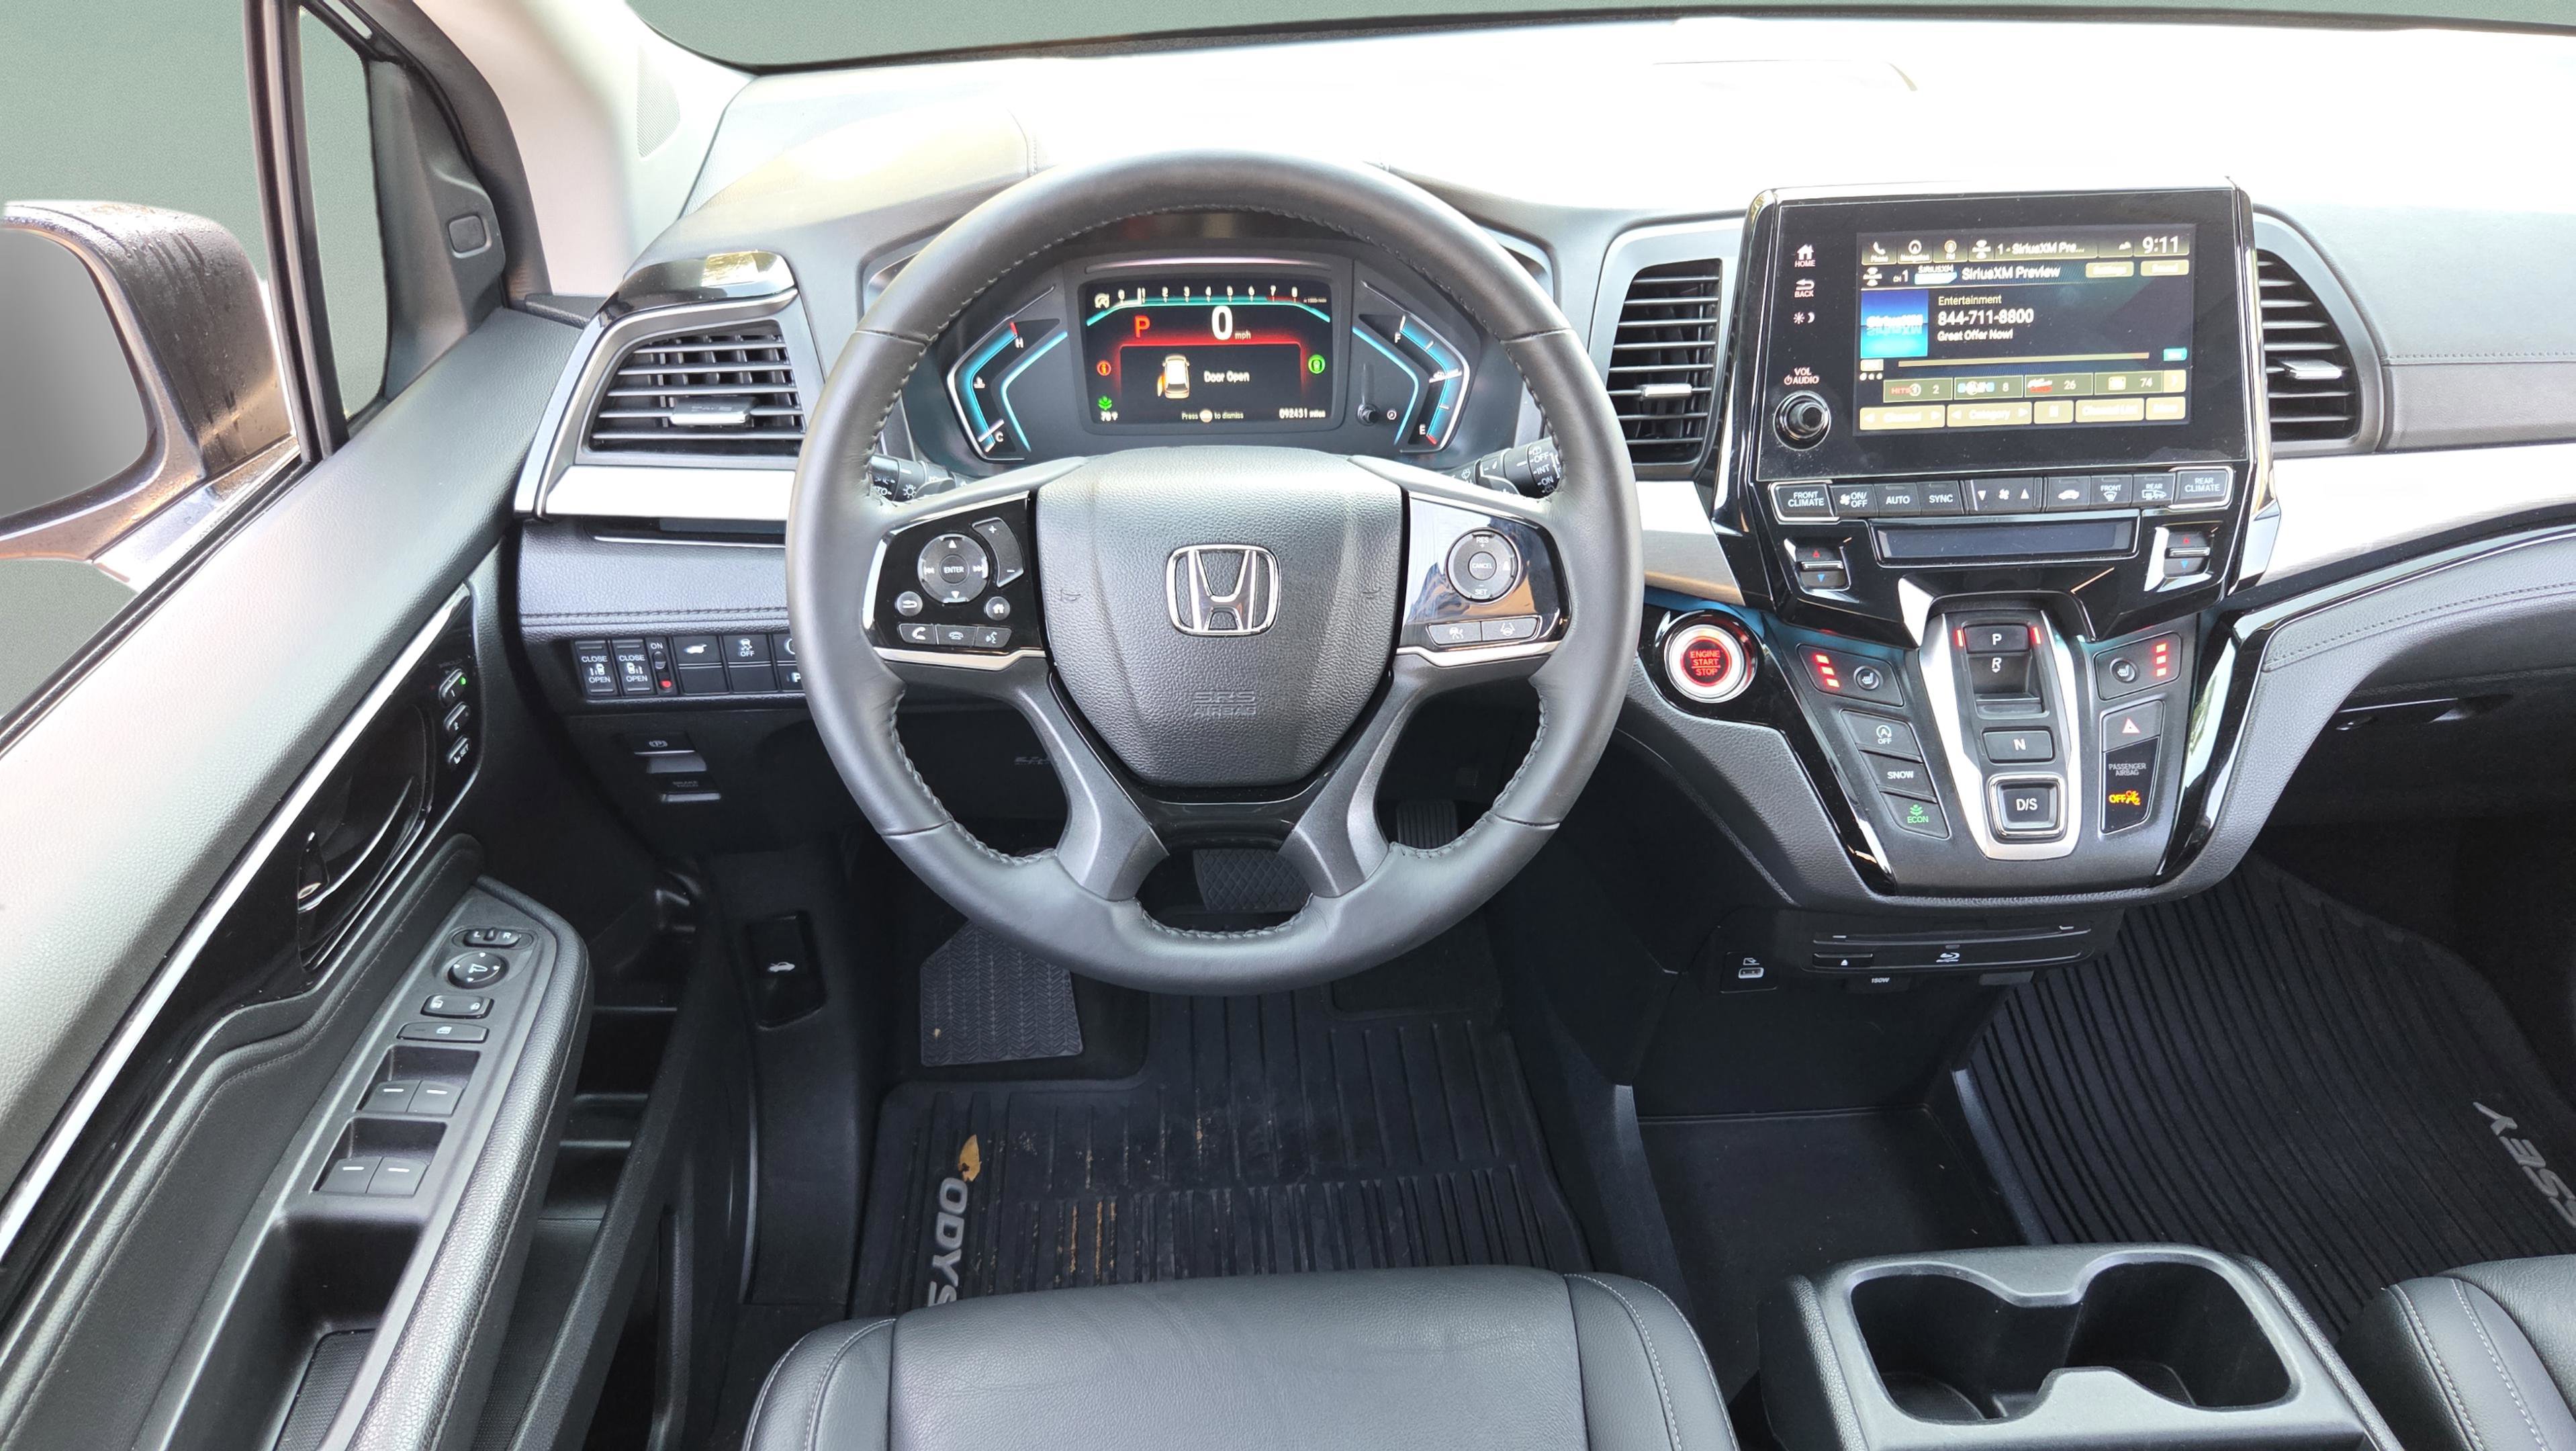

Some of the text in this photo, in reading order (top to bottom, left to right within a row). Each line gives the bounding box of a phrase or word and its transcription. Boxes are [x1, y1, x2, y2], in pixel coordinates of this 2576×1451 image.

[1997, 244, 2003, 255] 1
[2012, 241, 2057, 255] SiriusXM
[2142, 236, 2178, 254] 9:11
[1794, 259, 1816, 268] HOME
[1902, 269, 1908, 282] 1
[1962, 267, 2013, 281] SiriusXM
[2016, 265, 2061, 279] Preview
[1162, 286, 1168, 297] 2
[1794, 290, 1814, 298] BACK
[1938, 294, 2002, 306] Entertainment
[1938, 308, 2034, 326] 844-711-8800
[1134, 314, 1150, 338] P
[1211, 306, 1251, 341] 0 mph
[1395, 333, 1401, 344] F
[1938, 330, 1962, 342] Great
[1964, 329, 1987, 341] Offer
[1015, 337, 1024, 349] H
[1204, 370, 1250, 383] Door Open
[1794, 367, 1812, 376] VOL
[1792, 376, 1819, 385] AUDIO
[2064, 380, 2076, 390] 26
[2140, 378, 2154, 388] 74
[1933, 386, 1939, 394] 2
[2003, 383, 2009, 392] 8
[1222, 411, 1244, 419] dismiss
[1279, 408, 1308, 419] 092431
[1420, 424, 1426, 435] E
[995, 431, 1004, 443] C
[1534, 452, 1549, 463] OFF
[1536, 464, 1550, 475] INT
[1541, 476, 1553, 486] ON
[2195, 477, 2214, 485] REAR
[2100, 484, 2121, 492] FRONT
[2146, 483, 2163, 491] REAR
[2184, 483, 2221, 493] CLIMATE
[1793, 491, 1819, 500] FRONT
[1850, 492, 1868, 500] ON/
[1885, 495, 1911, 505] AUTO
[1929, 494, 1953, 504] SYNC
[1788, 497, 1825, 507] CLIMATE
[1850, 499, 1868, 509] OFF
[944, 566, 964, 574] ENTER
[1992, 633, 2003, 646] P
[650, 642, 663, 650] ON
[1690, 650, 1720, 658] ENGINE
[1692, 658, 1719, 666] START
[1991, 657, 2001, 669] R
[1695, 668, 1718, 676] STOP
[626, 674, 648, 683] OPEN
[2013, 738, 2027, 752] N
[459, 743, 469, 758] SET
[2109, 762, 2146, 771] PASSENGER
[1887, 771, 1914, 779] SNOW
[2109, 794, 2126, 803] OFF
[2016, 797, 2038, 811] D/S
[1907, 816, 1929, 824] ECON
[502, 931, 512, 939] R
